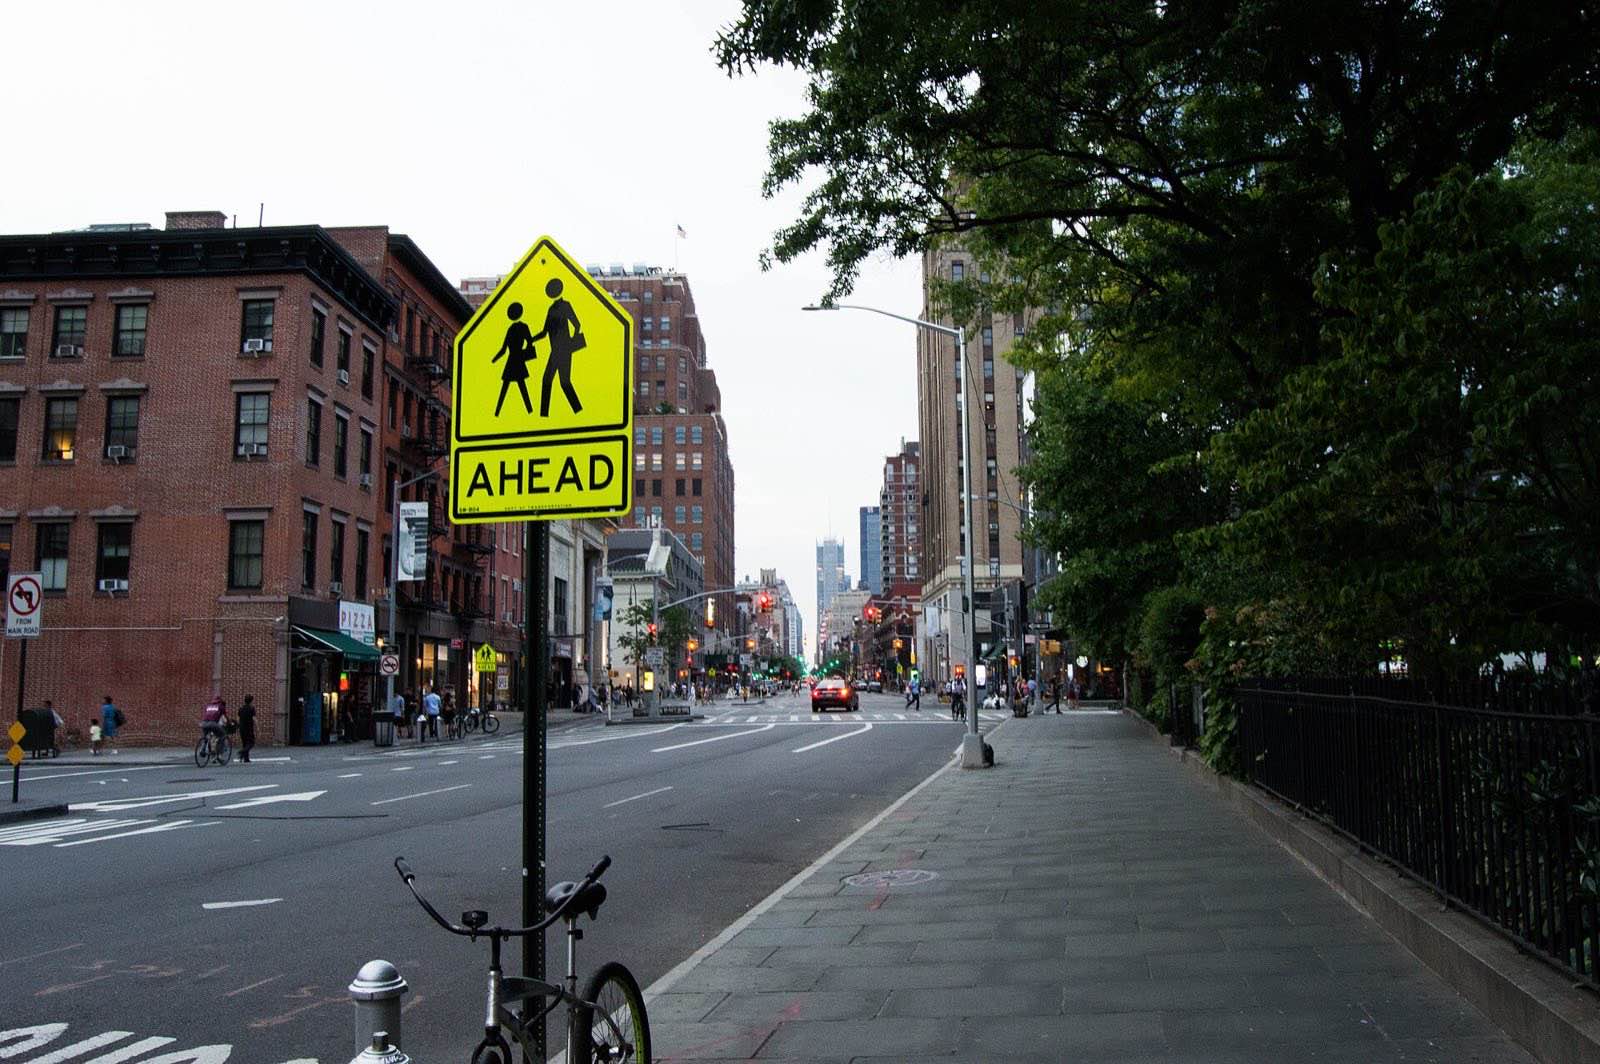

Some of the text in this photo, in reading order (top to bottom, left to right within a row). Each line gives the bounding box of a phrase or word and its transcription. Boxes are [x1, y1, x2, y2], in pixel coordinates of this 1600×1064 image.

[466, 454, 614, 498] AHEAD
[16, 617, 32, 625] FROM
[341, 609, 373, 630] PIZZA
[24, 626, 38, 634] ROAD
